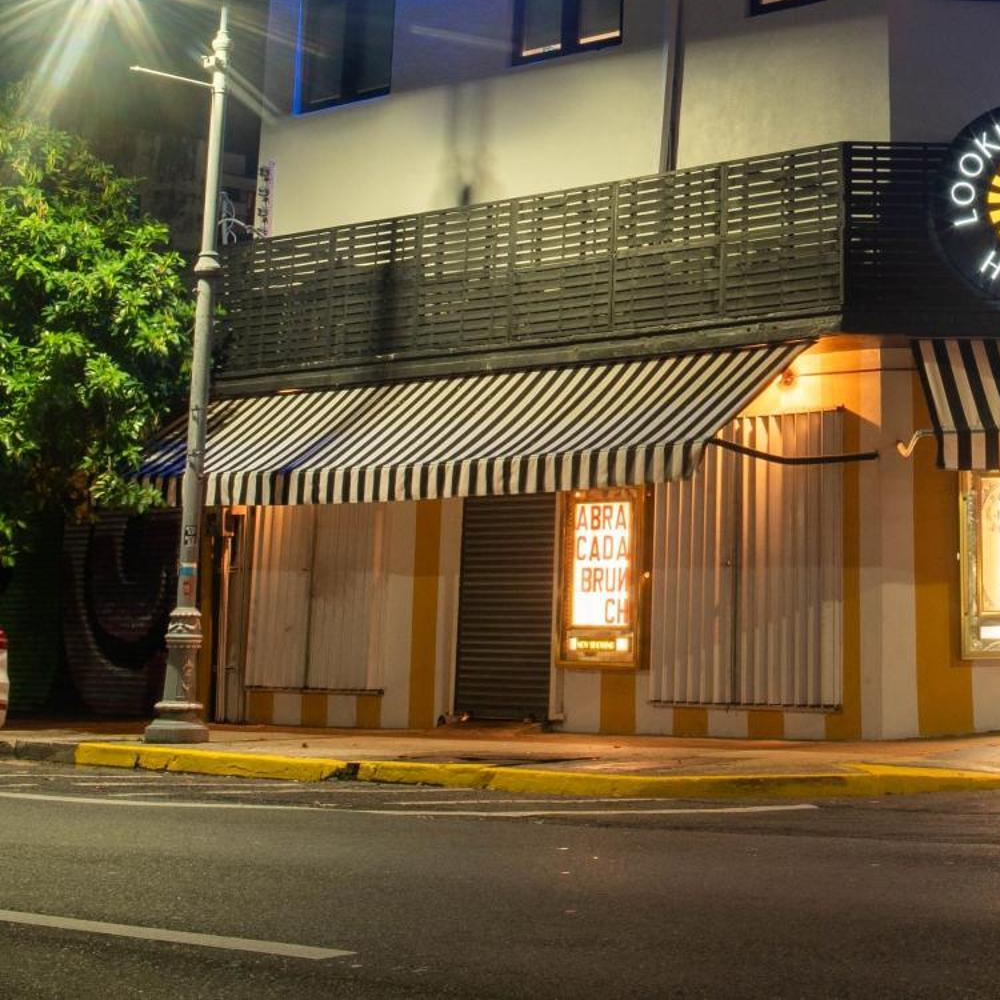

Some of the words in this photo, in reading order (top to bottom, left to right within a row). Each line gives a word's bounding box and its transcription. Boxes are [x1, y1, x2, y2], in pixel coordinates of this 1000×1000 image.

[575, 505, 627, 531] ABRA
[576, 535, 629, 561] CADA
[604, 598, 629, 624] CH
